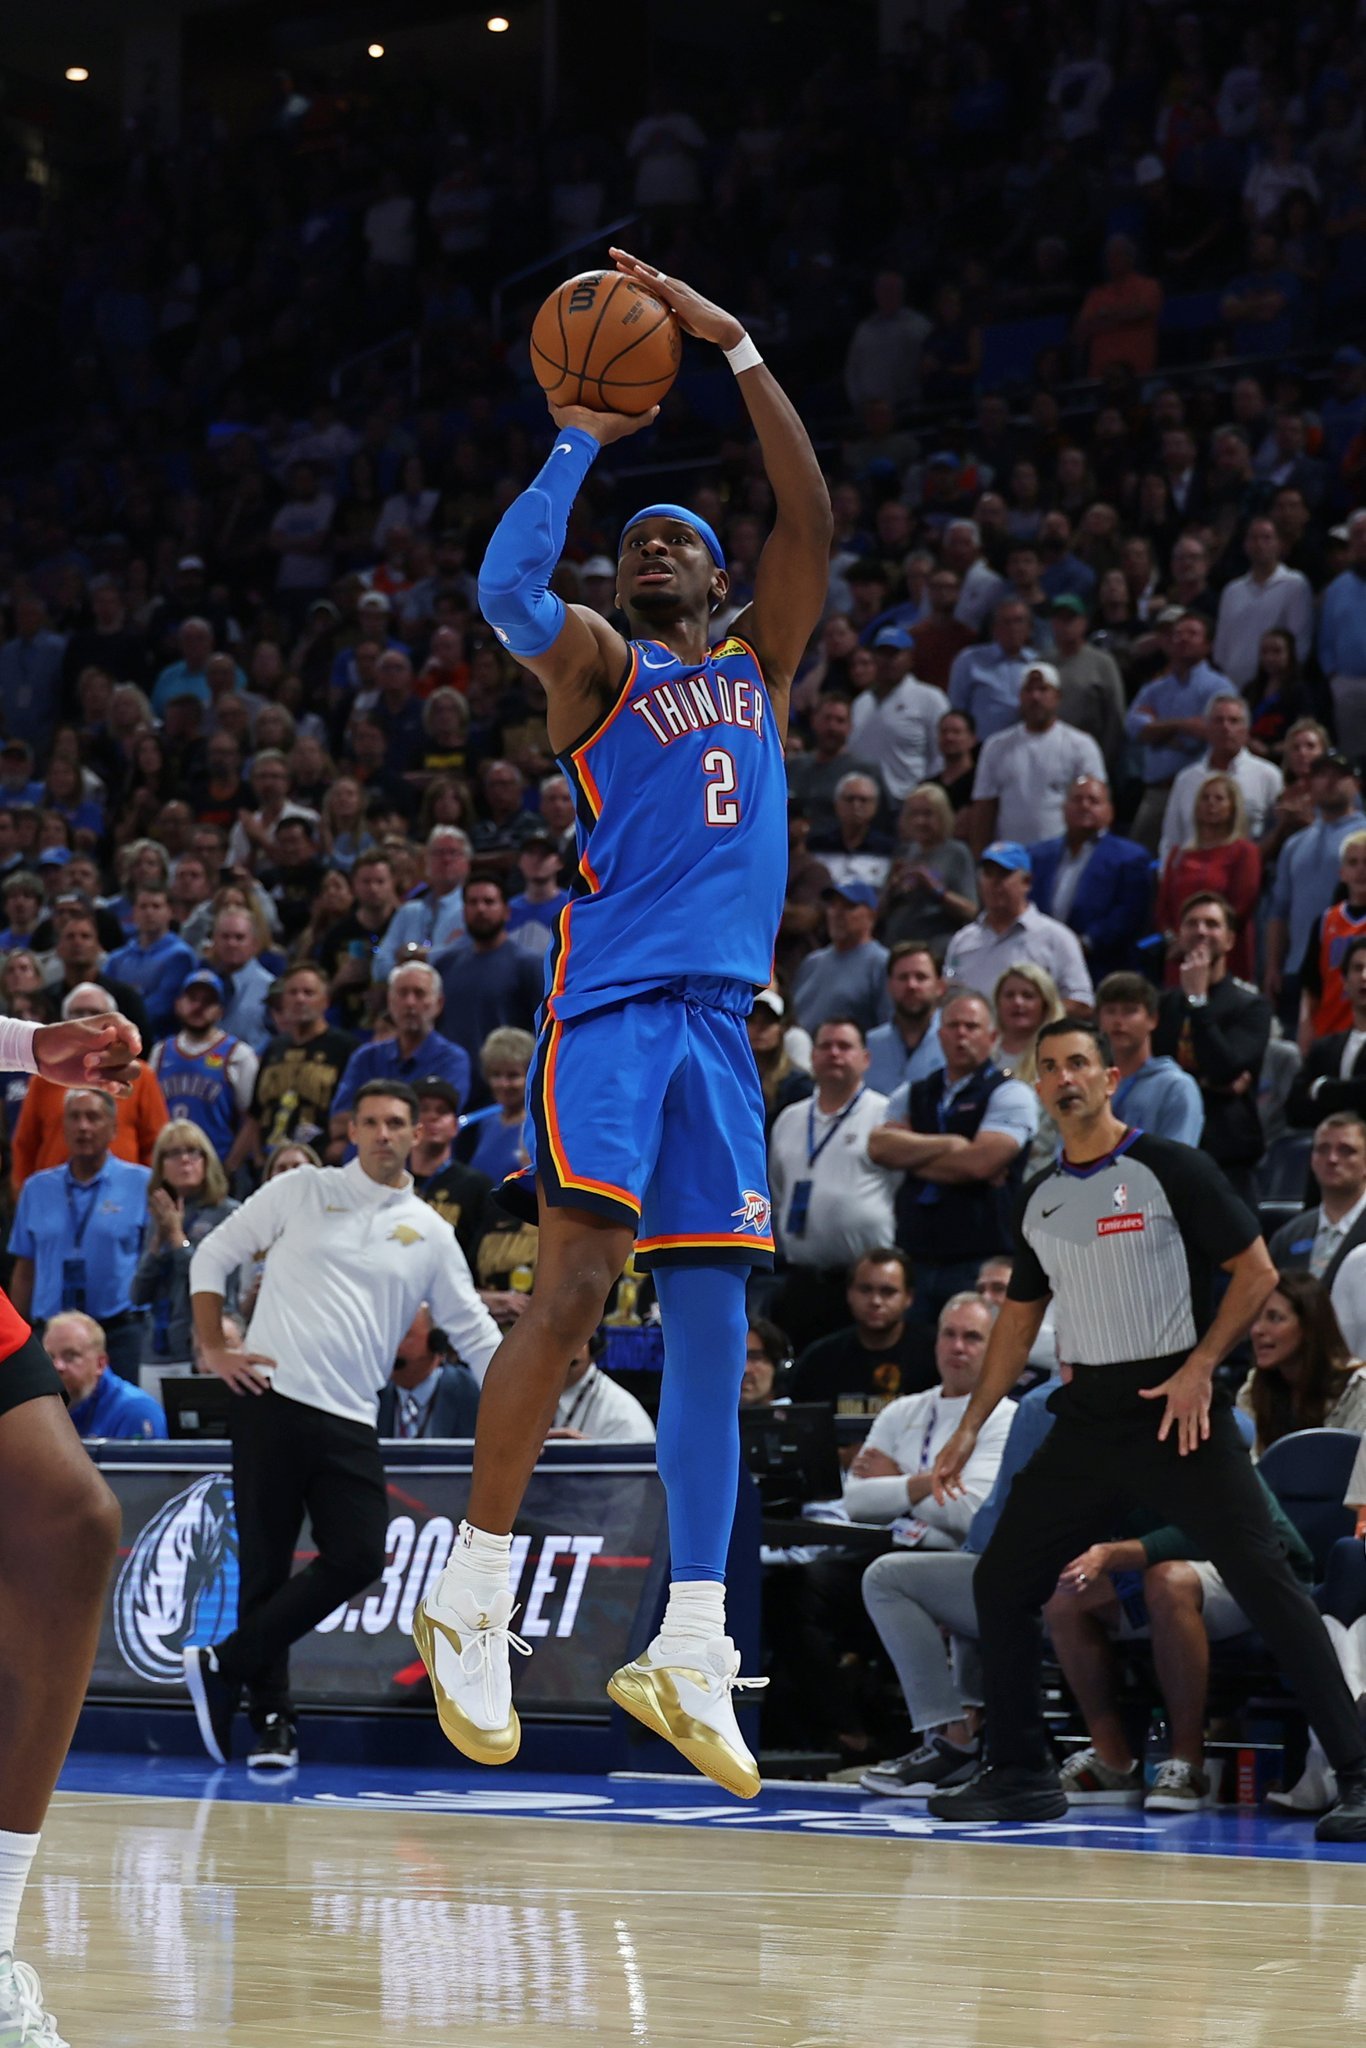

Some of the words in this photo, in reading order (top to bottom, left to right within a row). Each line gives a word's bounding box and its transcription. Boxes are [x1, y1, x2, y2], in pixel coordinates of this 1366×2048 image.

[631, 673, 764, 746] THUNDER
[703, 748, 740, 827] 2
[1098, 1218, 1143, 1233] Emirates
